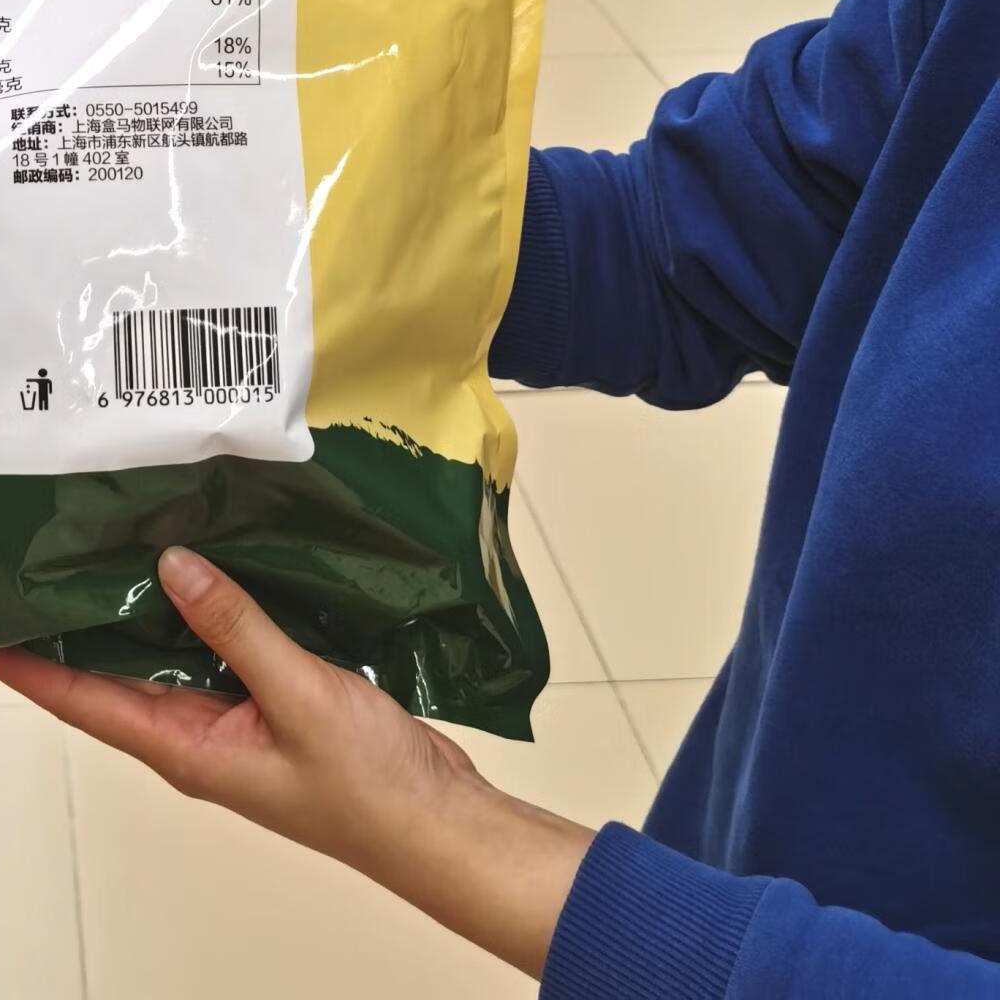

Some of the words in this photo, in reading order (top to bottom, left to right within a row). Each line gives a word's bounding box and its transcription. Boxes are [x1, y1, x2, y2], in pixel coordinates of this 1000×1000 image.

[213, 37, 252, 55] 18%
[215, 61, 252, 79] 15%
[11, 116, 234, 136] 销商：上海盒马物联网有限公司
[122, 389, 194, 408] 976813
